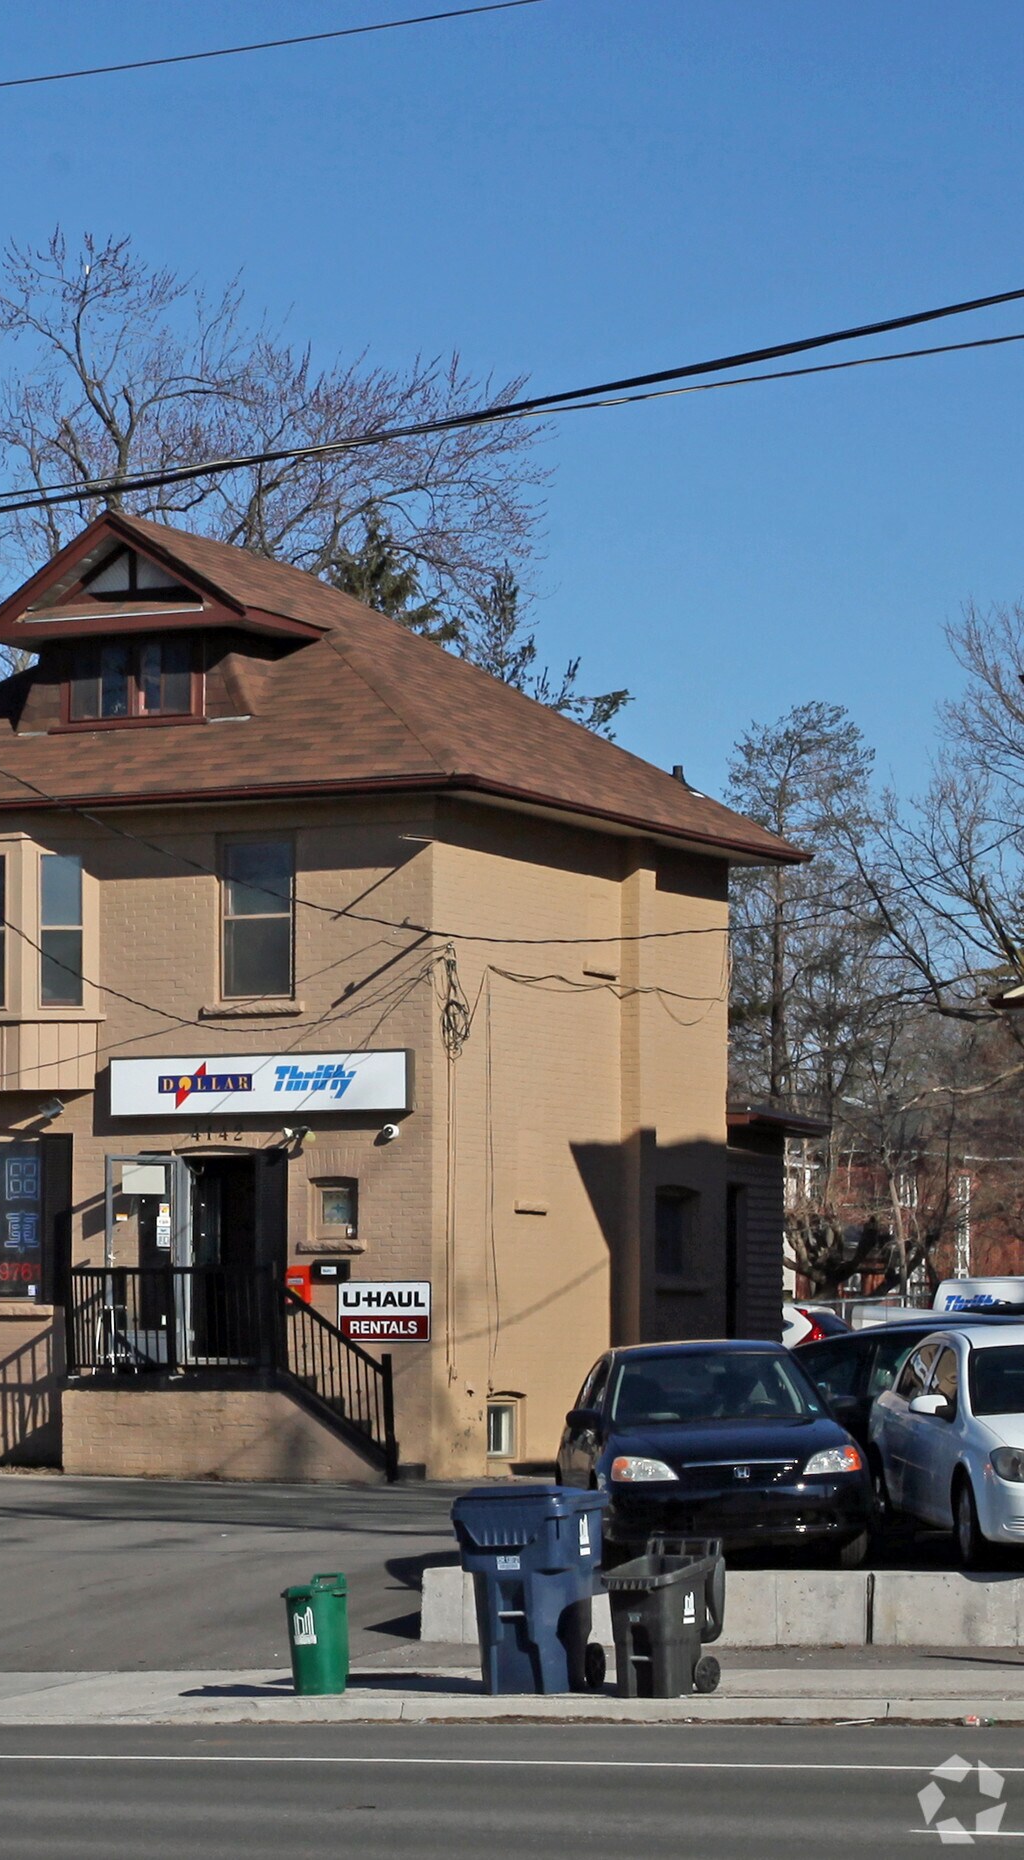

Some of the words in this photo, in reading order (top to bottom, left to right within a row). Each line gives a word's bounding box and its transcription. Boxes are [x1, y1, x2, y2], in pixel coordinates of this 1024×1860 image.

[161, 1075, 250, 1092] DOLLAR
[274, 1064, 357, 1098] Thrifty
[190, 1124, 244, 1142] 4142
[342, 1291, 425, 1307] U-HAUL
[350, 1321, 417, 1334] RENTALS
